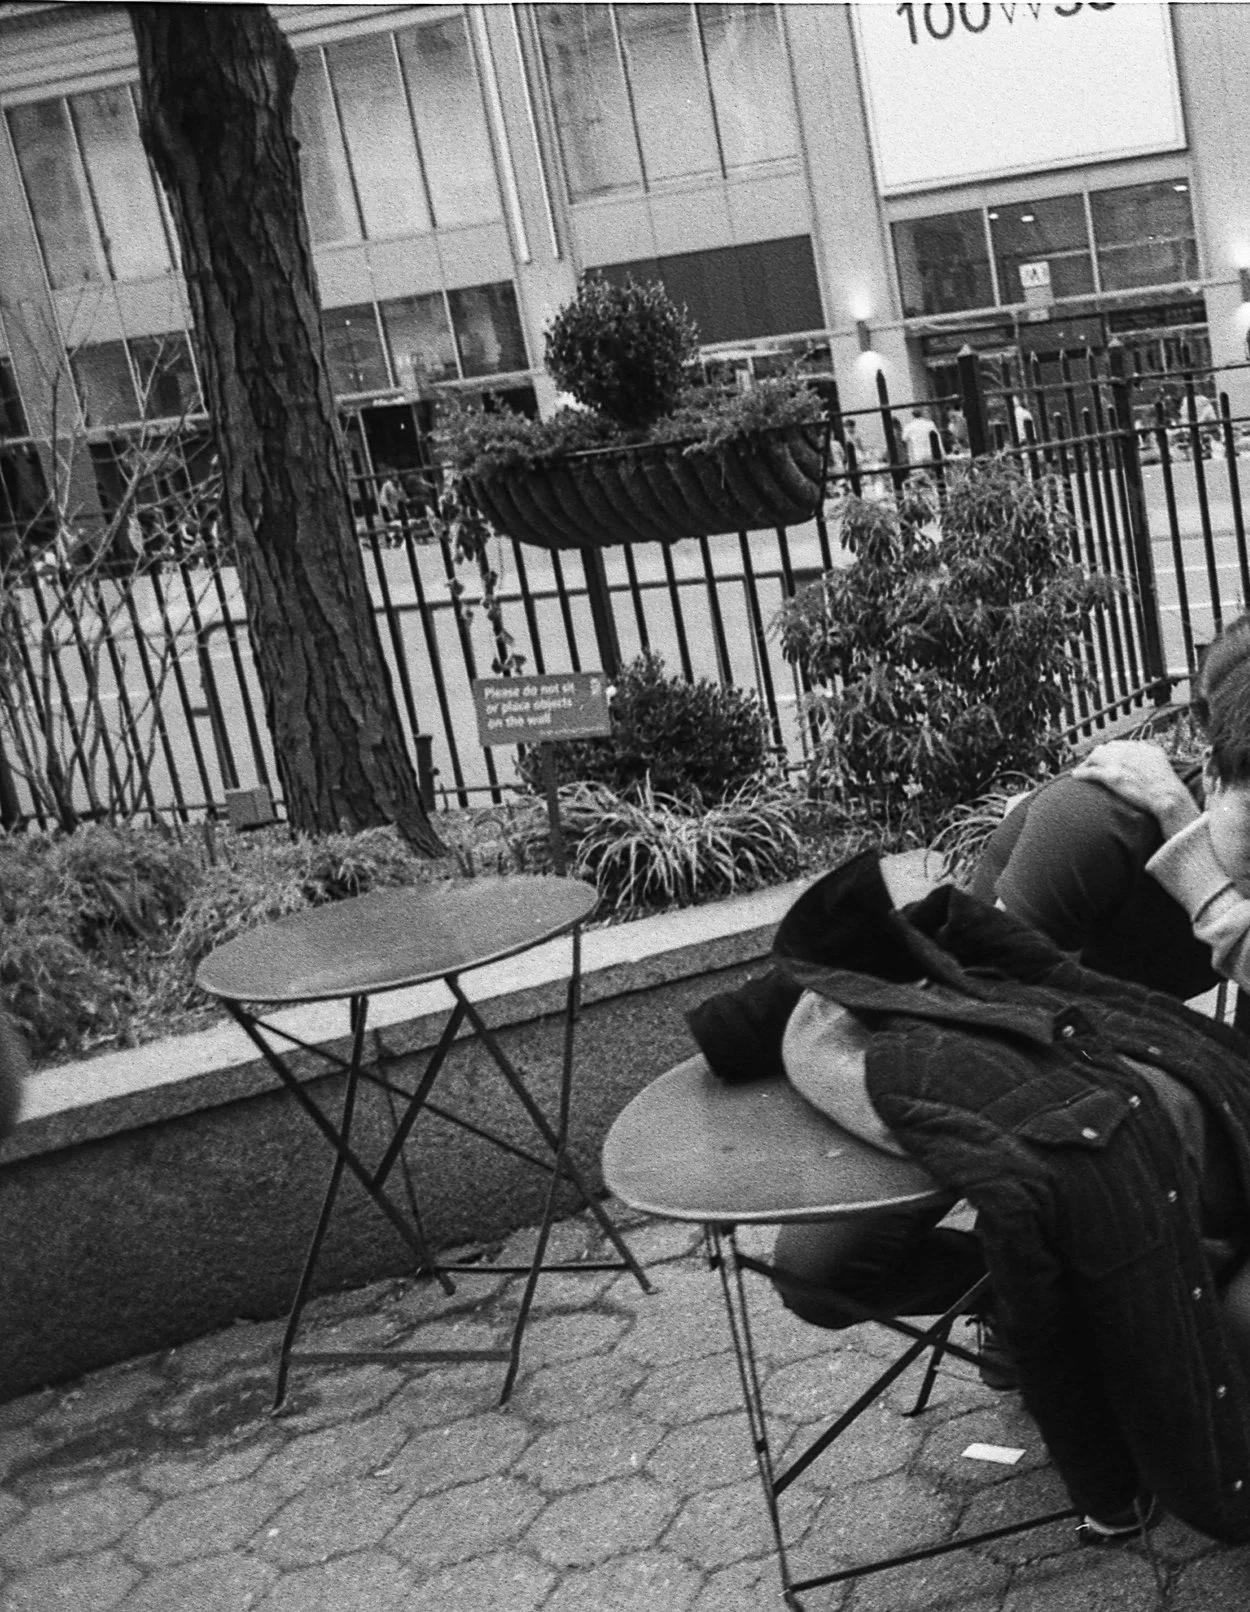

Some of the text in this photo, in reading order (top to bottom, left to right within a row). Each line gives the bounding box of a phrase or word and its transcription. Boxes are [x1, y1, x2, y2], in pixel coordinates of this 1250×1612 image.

[484, 686, 520, 699] Please
[522, 684, 538, 697] do
[540, 683, 560, 696] not
[501, 700, 531, 716] place
[487, 712, 552, 730] on the wall
